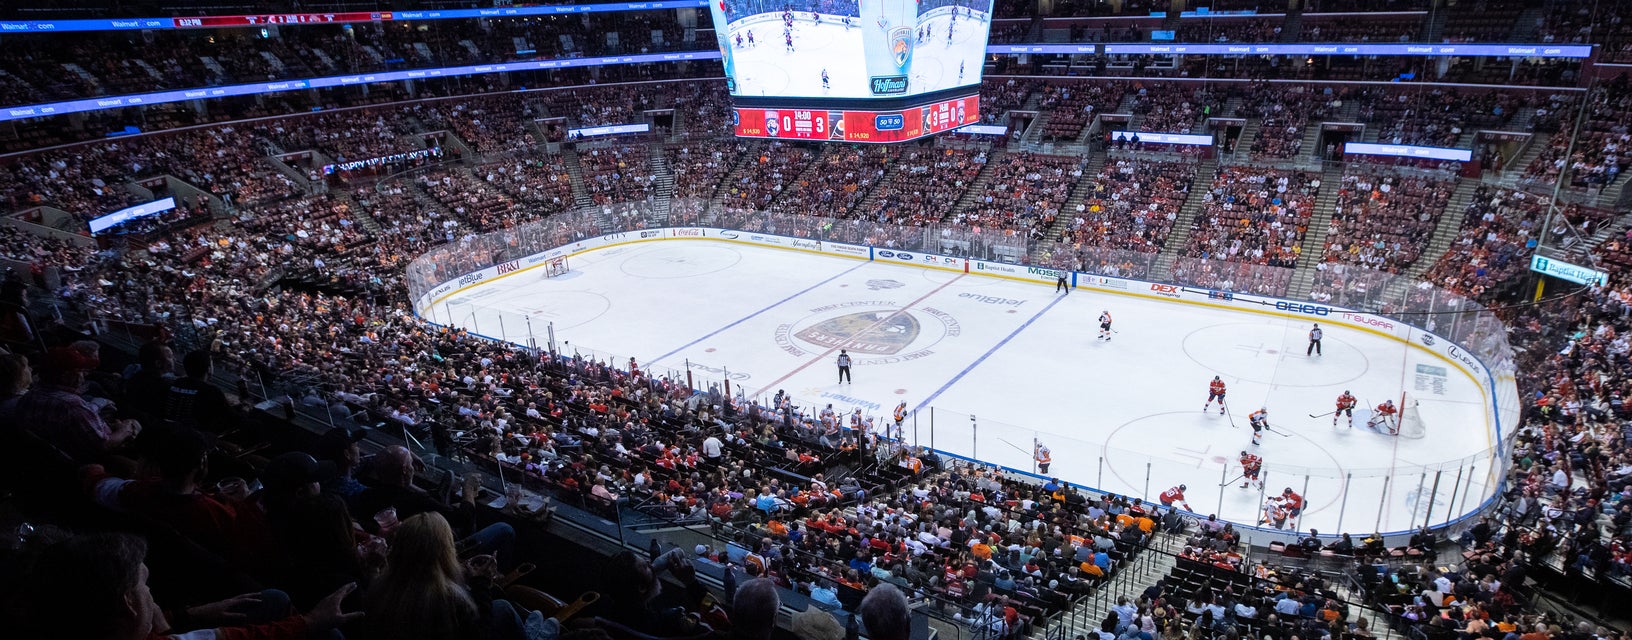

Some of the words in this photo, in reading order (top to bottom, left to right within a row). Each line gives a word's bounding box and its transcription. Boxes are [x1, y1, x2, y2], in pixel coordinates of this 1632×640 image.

[97, 99, 122, 107] Walmart
[10, 109, 36, 117] Walmart
[794, 111, 811, 120] 14:00
[933, 111, 938, 126] 3
[951, 107, 955, 122] 0
[783, 116, 791, 132] 0
[815, 117, 824, 132] 3
[496, 261, 520, 275] BB&T
[459, 272, 483, 288] jetBlue
[1150, 283, 1178, 293] DEX
[1276, 301, 1328, 316] GEICO
[1459, 353, 1480, 374] LEXUS
